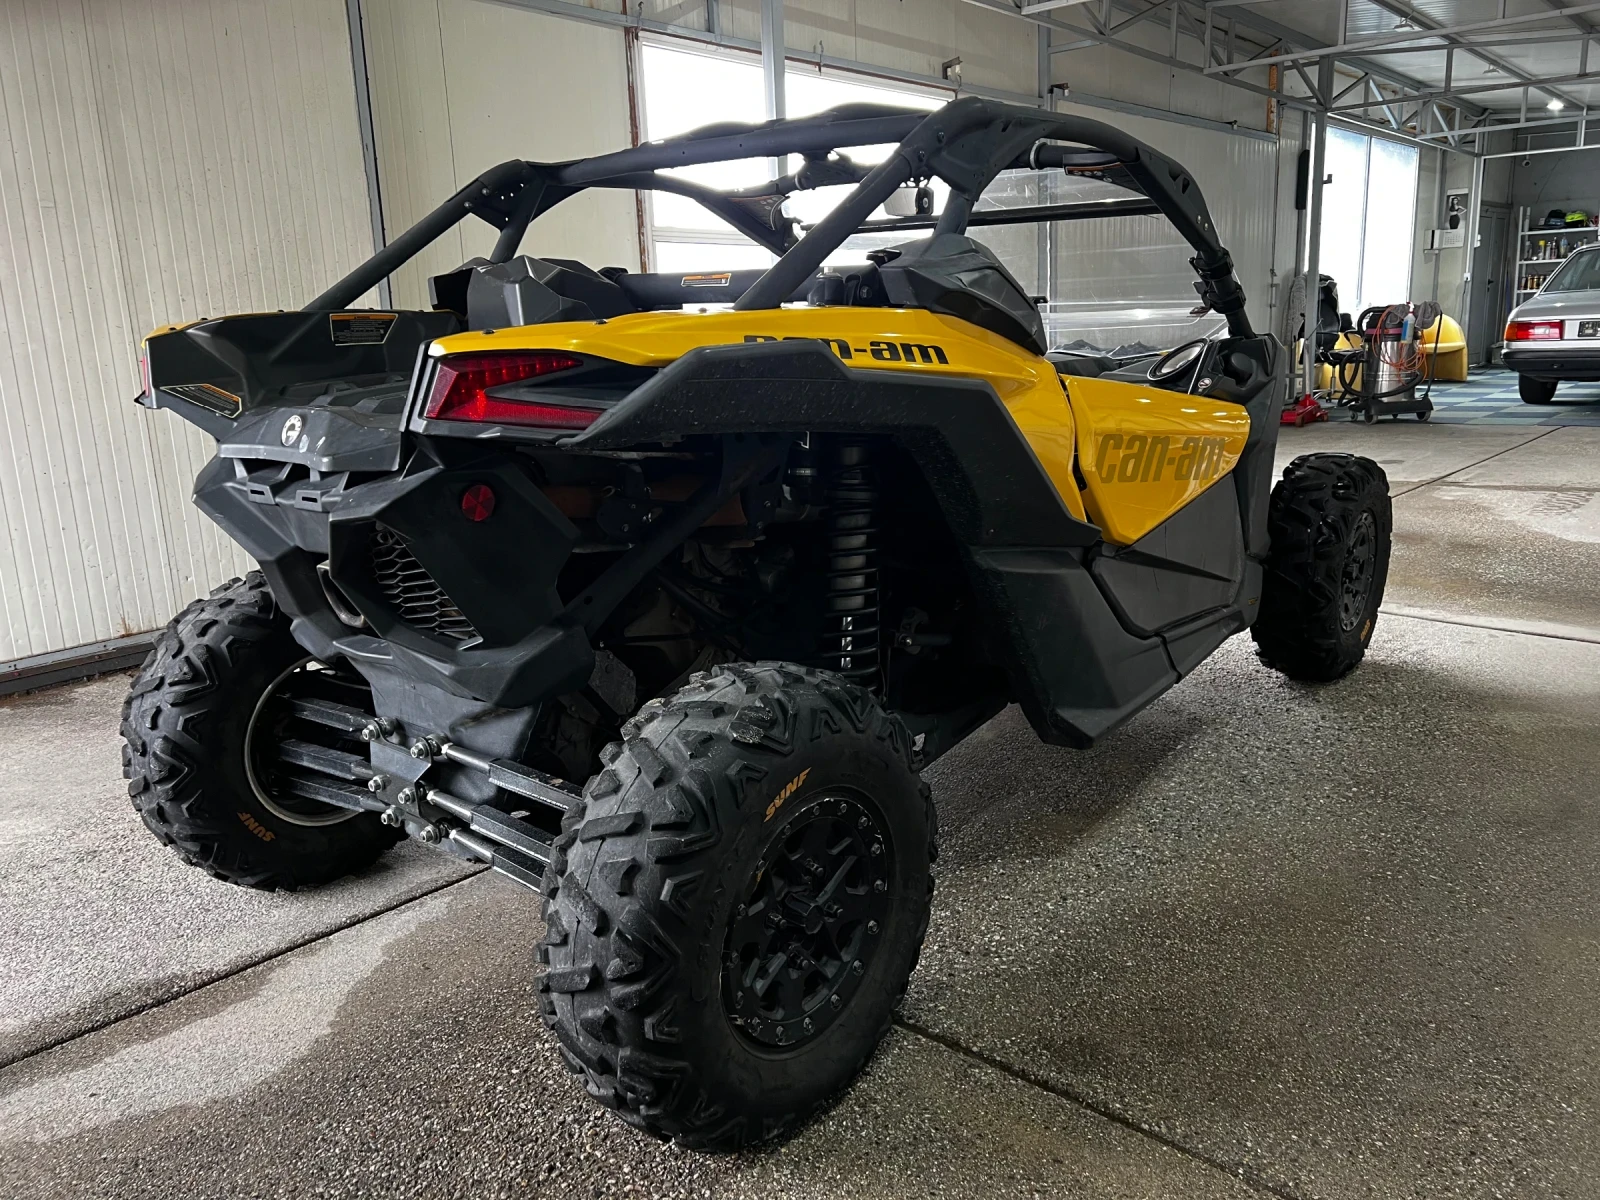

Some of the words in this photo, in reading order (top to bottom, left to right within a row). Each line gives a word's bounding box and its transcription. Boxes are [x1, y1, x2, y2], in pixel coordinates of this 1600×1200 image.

[743, 335, 949, 365] n-am
[1095, 433, 1226, 484] can-am
[763, 766, 812, 823] SUNF
[237, 812, 276, 842] SUNF
